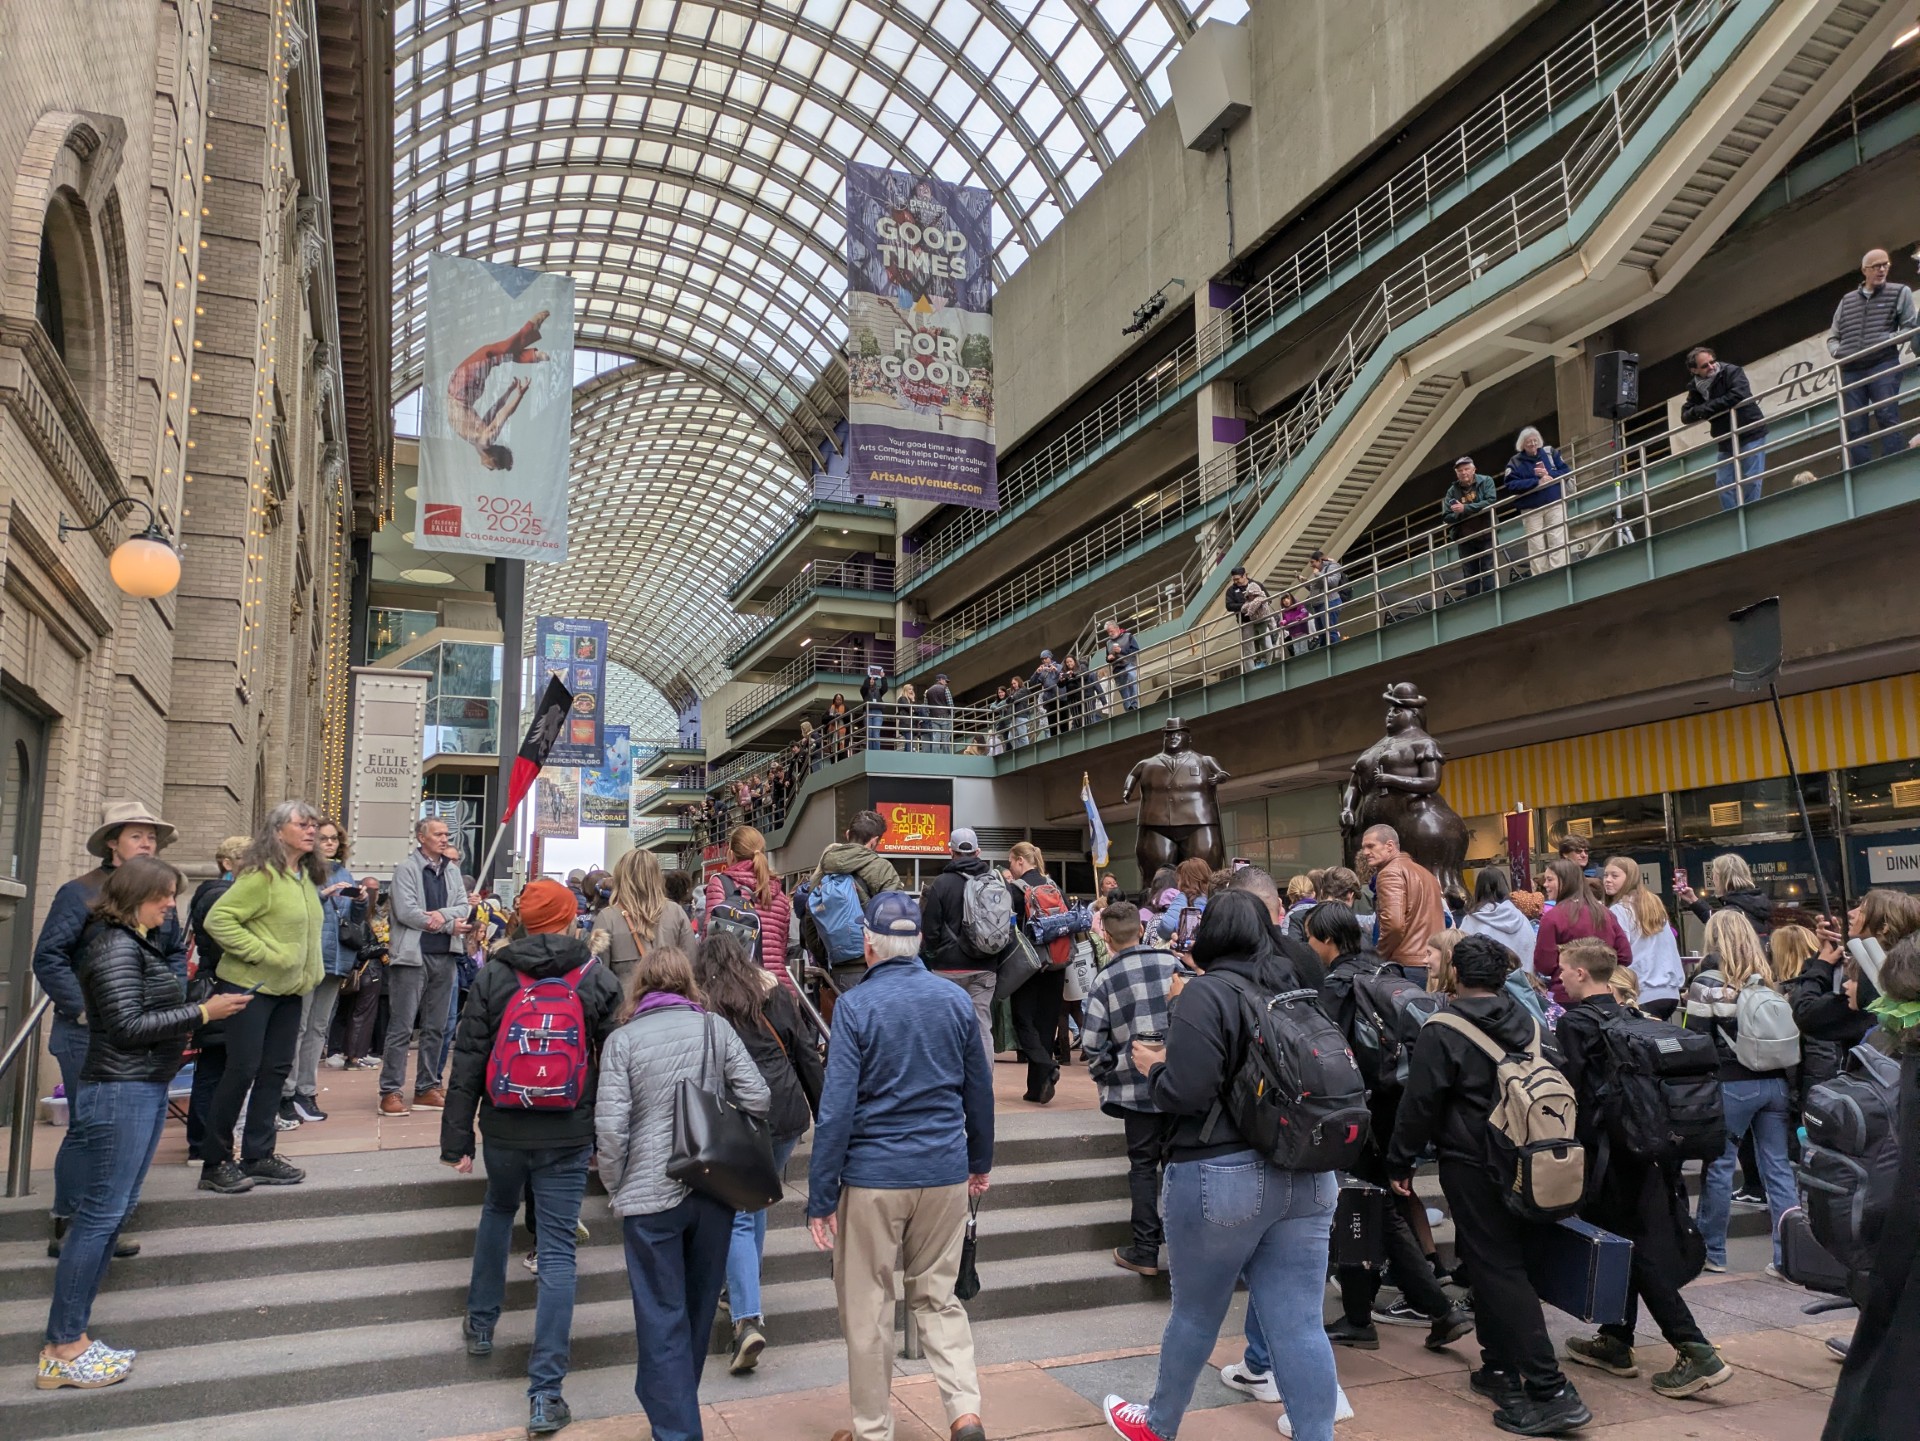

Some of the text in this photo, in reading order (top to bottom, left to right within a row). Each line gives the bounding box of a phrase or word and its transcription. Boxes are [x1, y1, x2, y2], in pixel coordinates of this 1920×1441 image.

[910, 200, 948, 212] DENVER
[876, 217, 966, 252] GOOD
[877, 244, 966, 279] TIMES
[894, 328, 957, 359] FOR
[880, 356, 970, 388] GOOD
[878, 445, 909, 456] Complex
[911, 450, 932, 458] helps
[934, 452, 964, 462] Denver's
[888, 437, 904, 446] Your
[906, 441, 926, 449] good
[928, 443, 944, 451] time
[954, 447, 967, 455] the
[874, 455, 914, 466] community
[917, 459, 938, 468] thrive
[960, 465, 980, 474] good!
[870, 471, 982, 495] ArtsAndVenues.com
[478, 496, 533, 516] 2024
[431, 525, 458, 533] BALLET
[487, 514, 542, 535] 2025
[465, 532, 560, 549] COLORADOBALLET.ORG
[368, 754, 407, 766] ELLIE
[364, 766, 410, 775] CAULKINS
[1886, 855, 1920, 870] DINN
[537, 1066, 547, 1077] A
[1352, 1213, 1361, 1239] 12822
